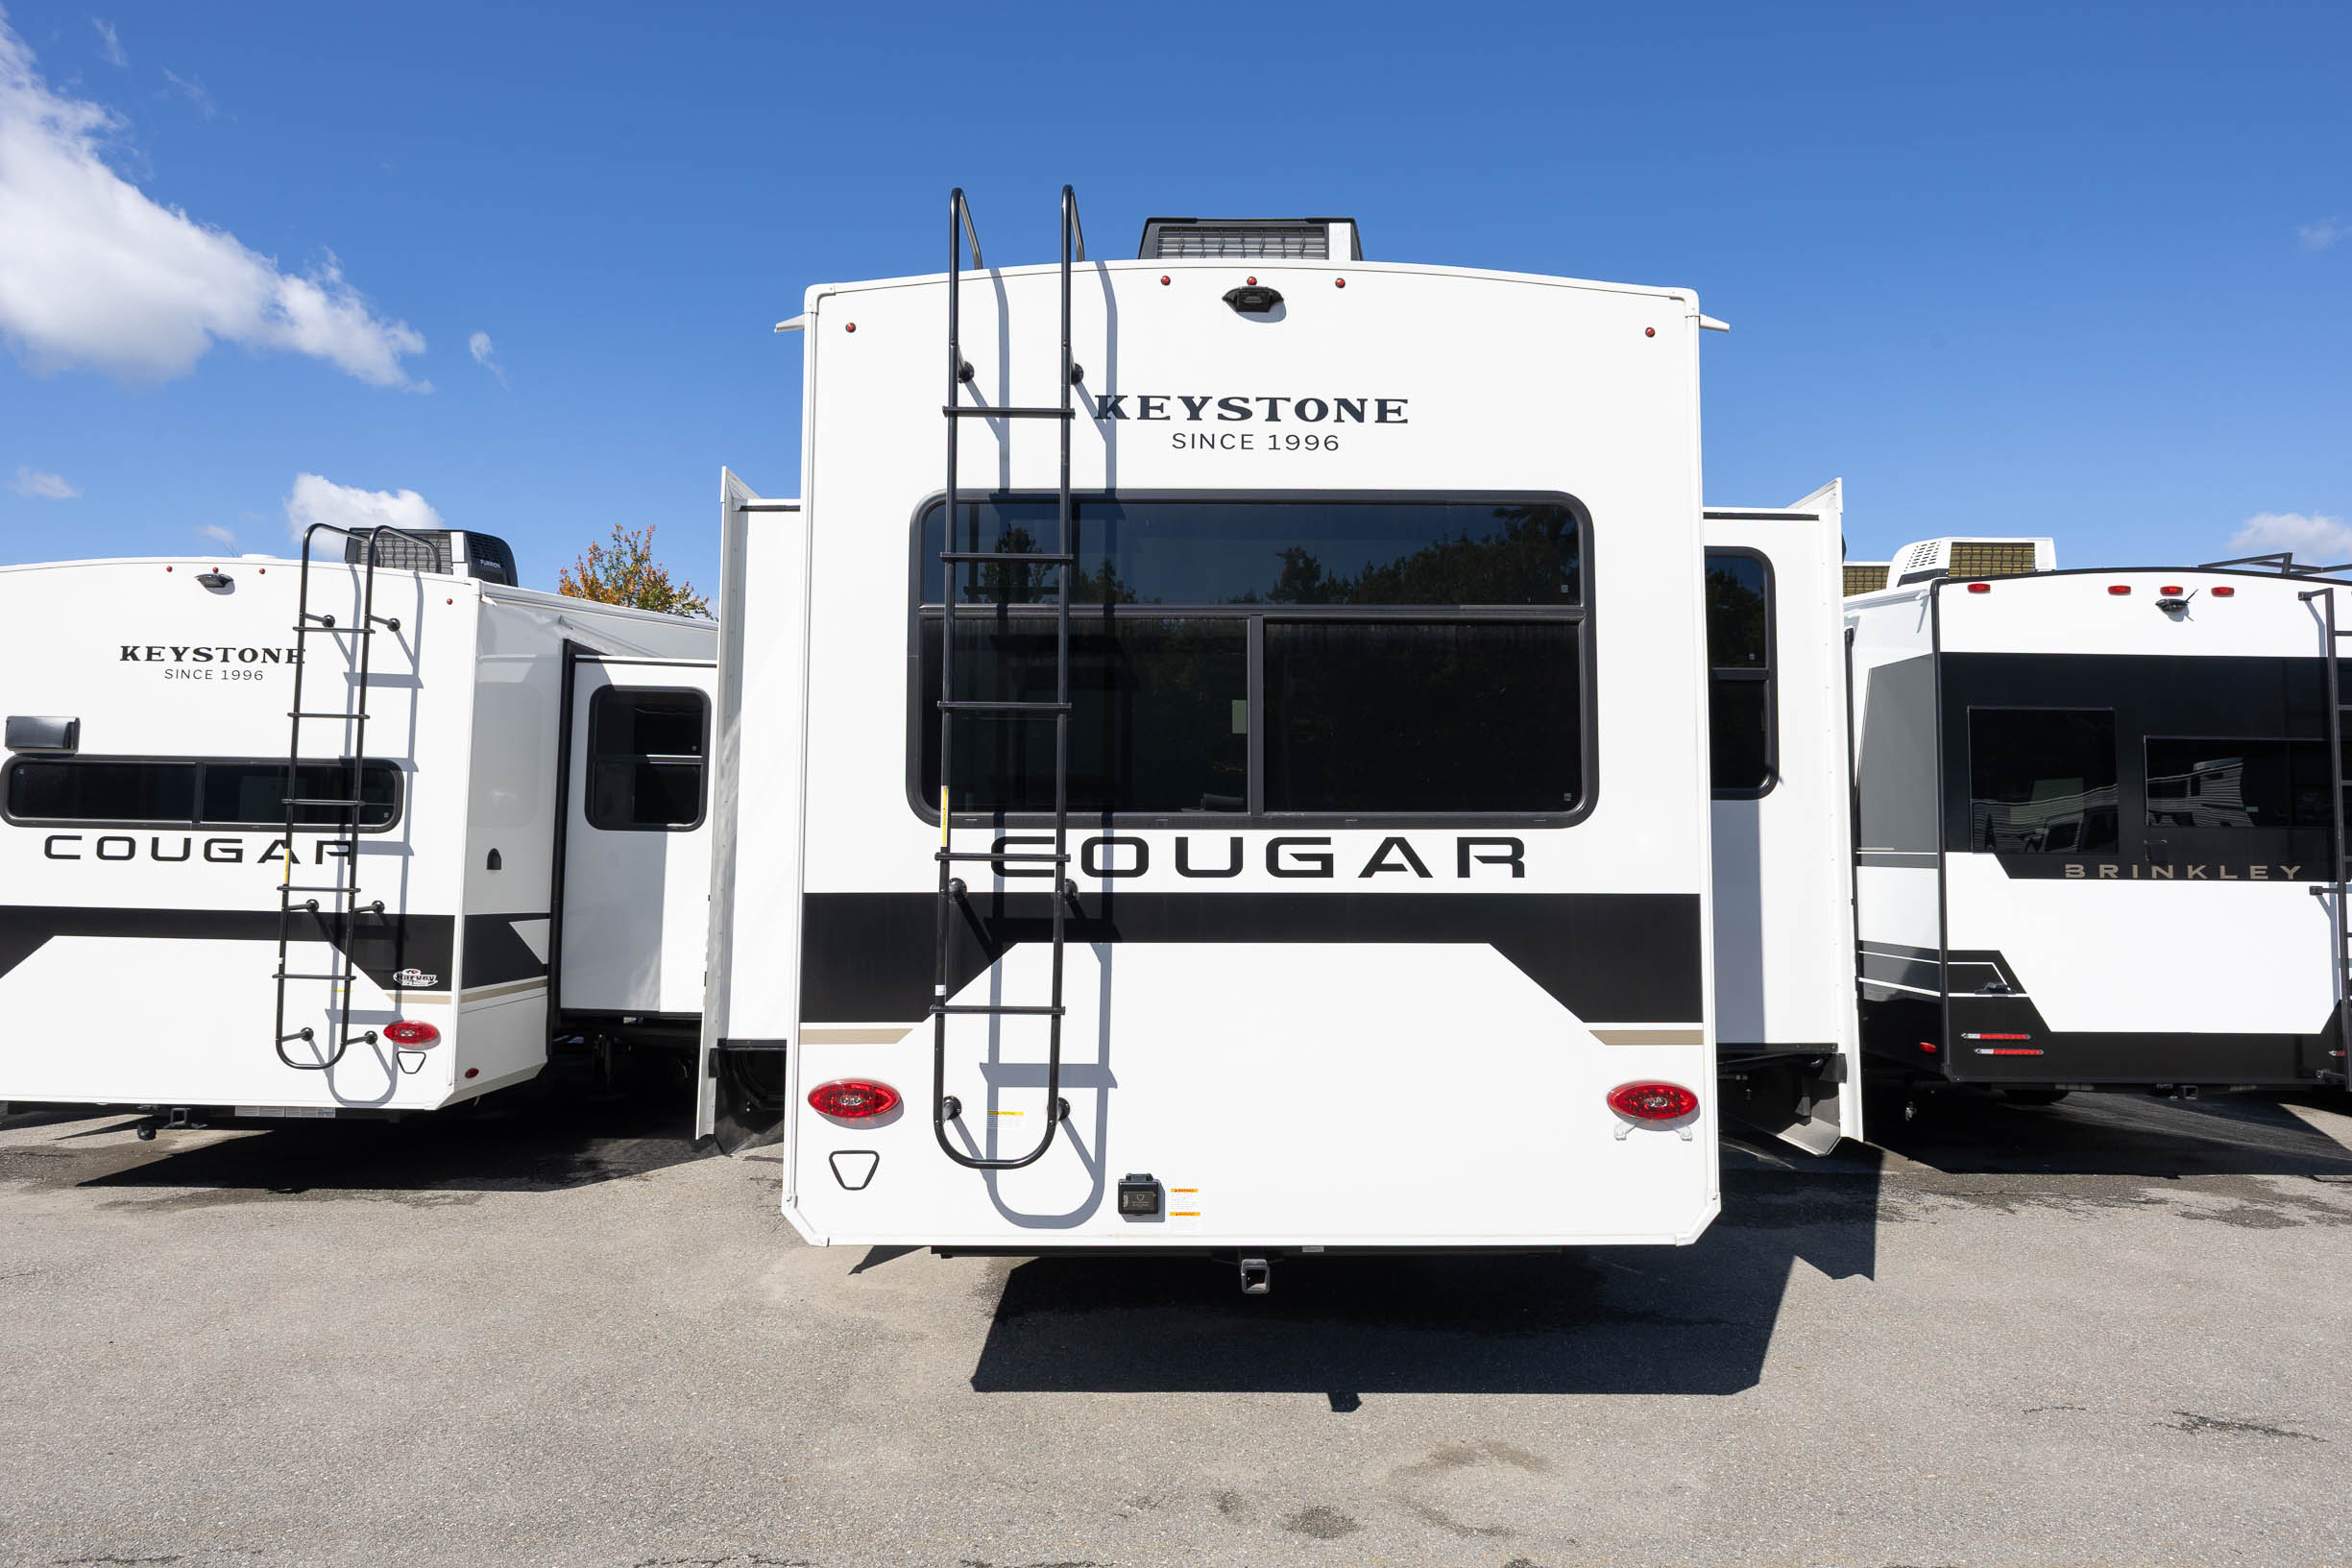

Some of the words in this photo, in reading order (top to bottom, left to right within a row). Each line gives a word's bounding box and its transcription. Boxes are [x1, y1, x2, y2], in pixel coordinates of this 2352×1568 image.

[1095, 395, 1408, 423] KEYSTONE
[1172, 432, 1254, 450] SINCE
[1268, 434, 1340, 451] 1996
[119, 645, 305, 664] KEYSTONE
[164, 668, 213, 681] SINCE
[221, 669, 264, 681] 1996
[43, 834, 352, 865] COUGAR
[990, 835, 1526, 879] COUGAR
[2064, 863, 2302, 880] BRINKLEY
